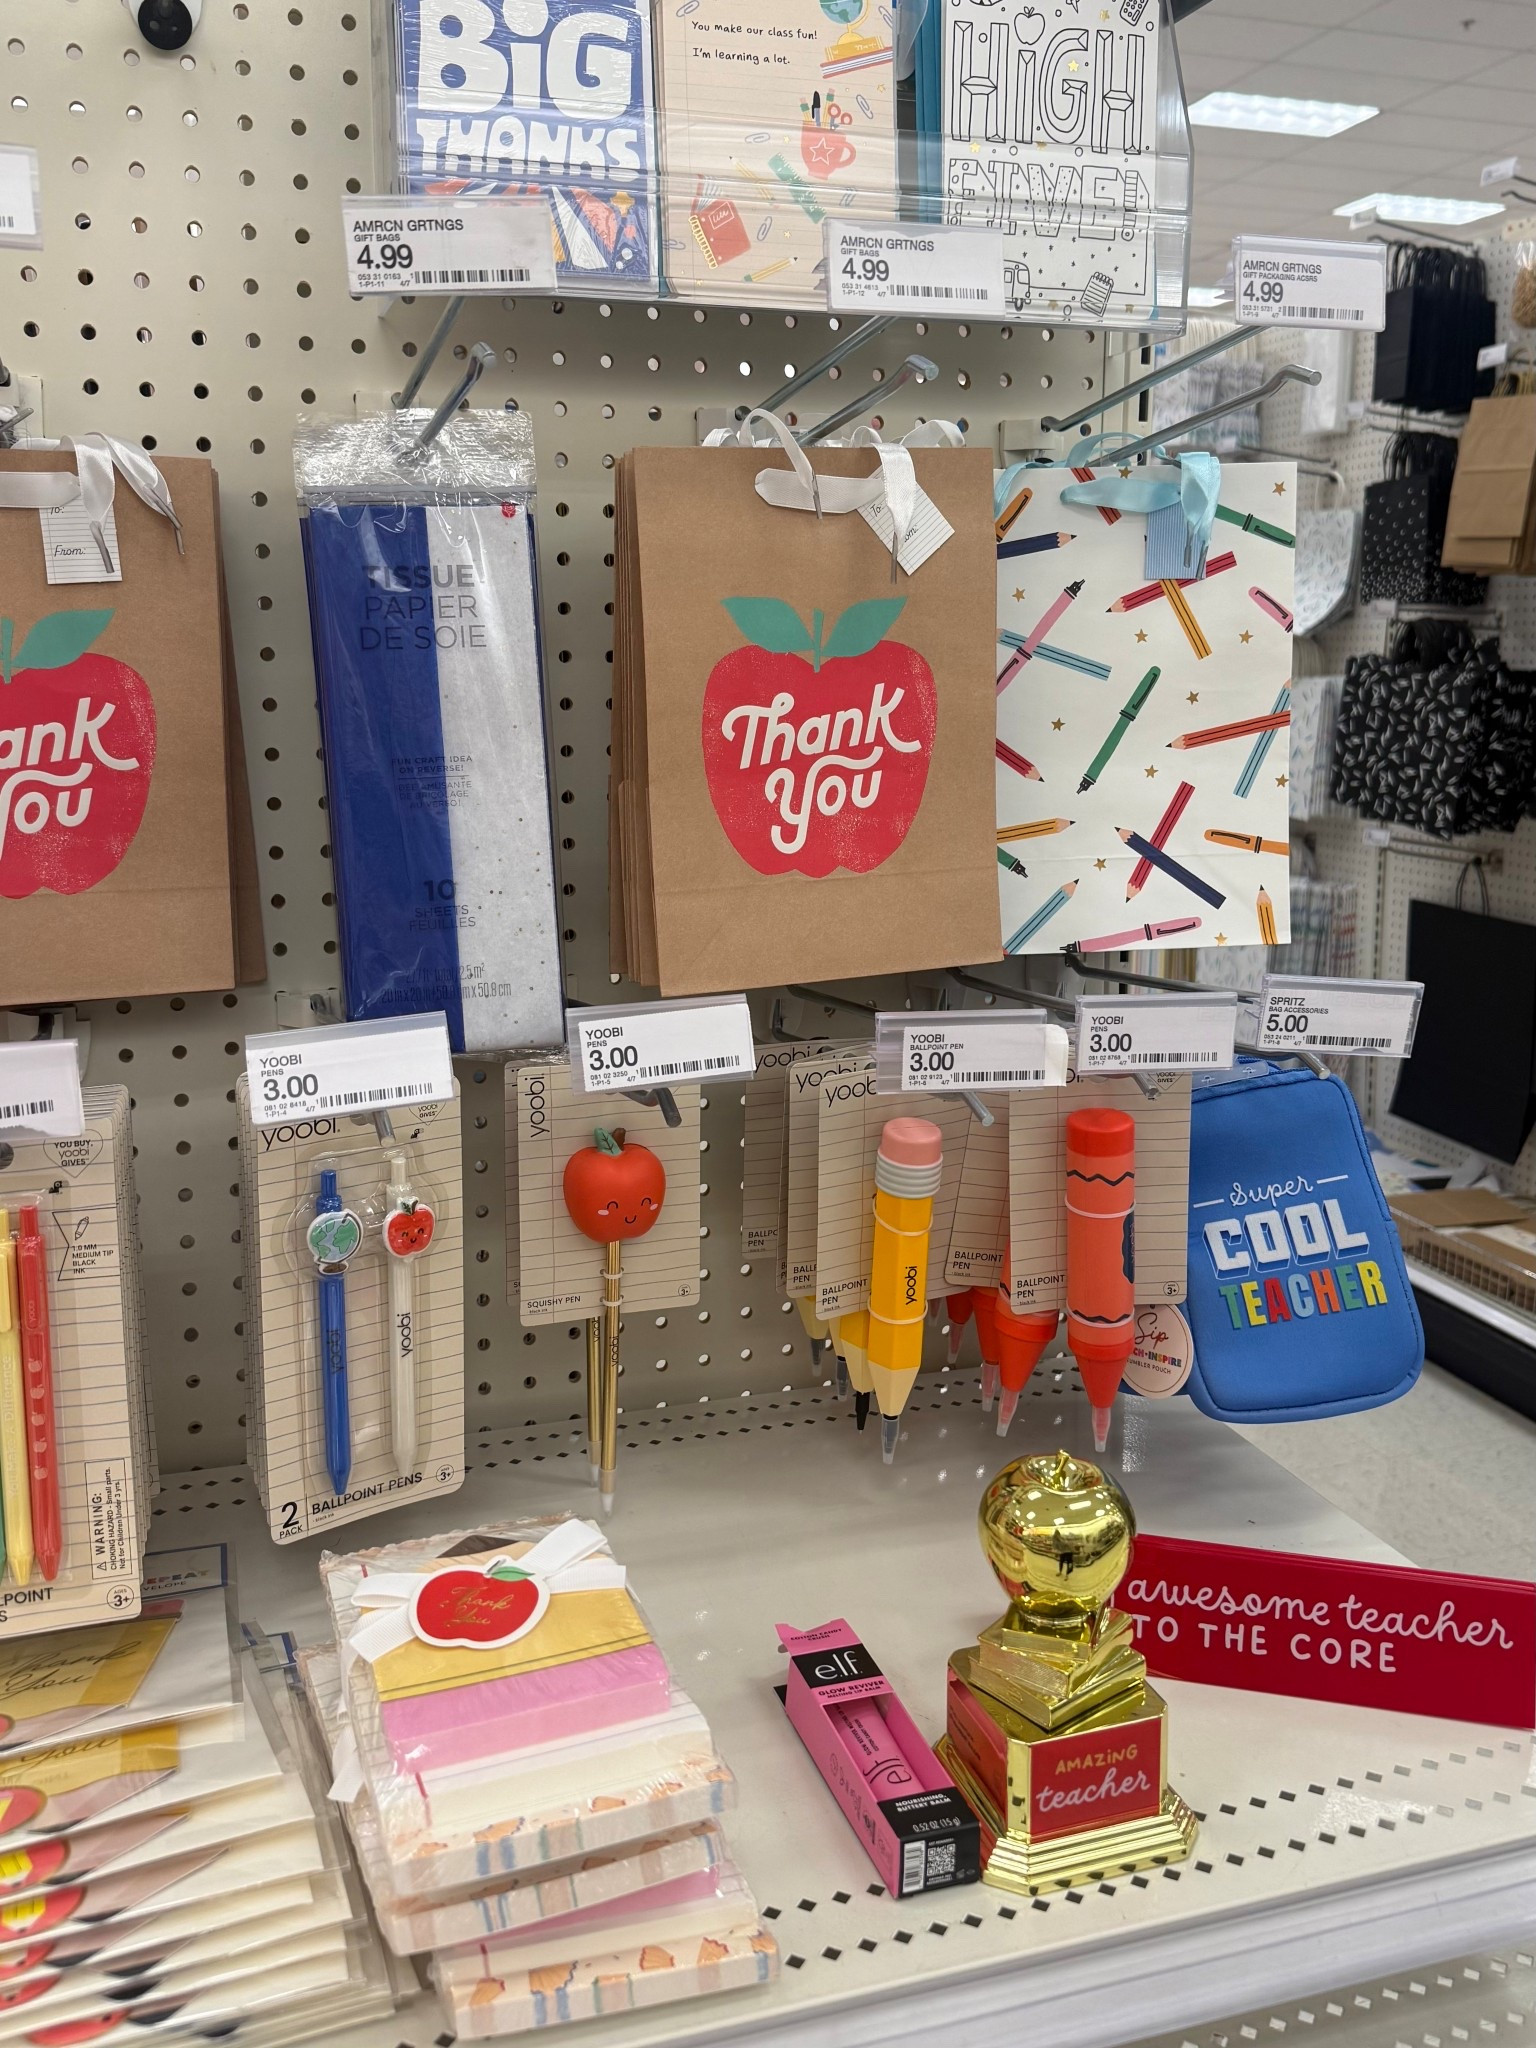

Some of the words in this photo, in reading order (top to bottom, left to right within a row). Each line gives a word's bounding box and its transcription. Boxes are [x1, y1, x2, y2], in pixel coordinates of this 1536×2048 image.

[692, 21, 710, 32] You
[714, 23, 742, 35] make
[747, 28, 763, 36] our
[768, 27, 793, 38] class
[797, 28, 818, 40] fun!
[693, 47, 711, 59] I'm
[715, 48, 759, 65] learning
[764, 56, 770, 64] a
[773, 54, 791, 65] lot.
[416, 116, 641, 182] THANKS
[353, 220, 403, 233] AMRCN
[407, 219, 464, 231] GRTNGS
[354, 234, 374, 242] GIFT
[376, 234, 401, 242] BAGS
[840, 236, 883, 249] AMRCN
[886, 239, 934, 251] GRTNGS
[357, 244, 413, 269] 4.99
[840, 248, 857, 256] GIFT
[842, 257, 890, 281] 4.99
[1243, 260, 1279, 271] AMRCN
[1282, 263, 1322, 274] GRTNGS
[1259, 272, 1295, 281] PACKAGING
[1243, 281, 1283, 303] 4.99
[870, 503, 883, 517] To:
[54, 545, 86, 557] From:
[362, 565, 475, 588] TISSUE
[365, 595, 479, 620] PAPIER
[361, 627, 403, 650] DE
[415, 625, 487, 649] SOIE
[0, 697, 140, 771] ank
[721, 683, 922, 770] Thank
[449, 755, 473, 763] IDEA
[423, 879, 455, 902] 10
[415, 905, 469, 918] SHEETS
[409, 917, 476, 931] FEUILLES
[477, 982, 497, 998] 50.8
[499, 982, 512, 996] cm
[1270, 997, 1306, 1007] SPRITZ
[1283, 1006, 1329, 1015] ACCESSORIES
[1091, 1016, 1124, 1025] YOOBI
[1266, 1014, 1309, 1033] 5.00
[585, 1026, 624, 1040] YOOBI
[910, 1034, 945, 1044] YOOBI
[587, 1040, 608, 1049] PENS
[1089, 1033, 1132, 1053] 3.00
[260, 1054, 302, 1069] YOOBI
[589, 1045, 638, 1071] 3.00
[910, 1051, 954, 1072] 3.00
[261, 1069, 284, 1078] PENS
[591, 1079, 611, 1087] 1-P1-5
[627, 1075, 636, 1083] 4/7
[263, 1073, 319, 1102] 3.00
[265, 1110, 287, 1118] 1-P1-4
[54, 1141, 73, 1149] YOU
[58, 1144, 90, 1160] yoobi
[1229, 1175, 1314, 1208] Super
[1202, 1198, 1370, 1280] COOL
[72, 1251, 101, 1259] MEDIUM
[954, 1251, 1004, 1262] BALLPOINT
[72, 1259, 96, 1267] BLACK
[953, 1261, 971, 1270] PEN
[793, 1275, 810, 1283] PEN
[905, 1265, 918, 1305] yoobi
[1017, 1275, 1066, 1289] BALLPOINT
[822, 1279, 868, 1296] BALLPOINT
[1017, 1289, 1034, 1299] PEN
[1167, 1287, 1177, 1295] 3+
[1218, 1260, 1388, 1329] TEACHER
[527, 1298, 563, 1309] SQUISHY
[565, 1296, 581, 1304] PEN
[822, 1296, 839, 1306] PEN
[397, 1311, 413, 1358] yoobi
[1135, 1312, 1169, 1350] Sip
[327, 1330, 344, 1375] yoobi
[1152, 1364, 1172, 1375] POUCH
[105, 1467, 113, 1486] parts.
[440, 1471, 451, 1481] 3+
[312, 1482, 385, 1515] BALLPOINT
[388, 1472, 423, 1491] PENS
[281, 1501, 300, 1529] 2
[92, 1493, 106, 1556] WARNING:
[107, 1510, 115, 1537] HAZARD
[117, 1520, 125, 1547] Children
[279, 1524, 303, 1539] PACK
[146, 1570, 209, 1585] EPEAT
[143, 1581, 186, 1591] VELOPE
[0, 1587, 54, 1606] POINT
[114, 1594, 130, 1607] 3+
[440, 1586, 512, 1611] Thank
[1127, 1577, 1331, 1626] awesome
[1338, 1595, 1514, 1650] teacher
[1131, 1615, 1179, 1643] TO
[1198, 1622, 1268, 1656] THE
[1290, 1634, 1397, 1674] CORE
[818, 1687, 846, 1696] GLOW
[848, 1680, 885, 1691] REVIVER
[827, 1691, 853, 1699] MELTING
[1036, 1767, 1151, 1813] teacher
[897, 1802, 929, 1812] BUTTERY
[929, 1797, 951, 1806] BALM
[912, 1823, 930, 1833] 0.52
